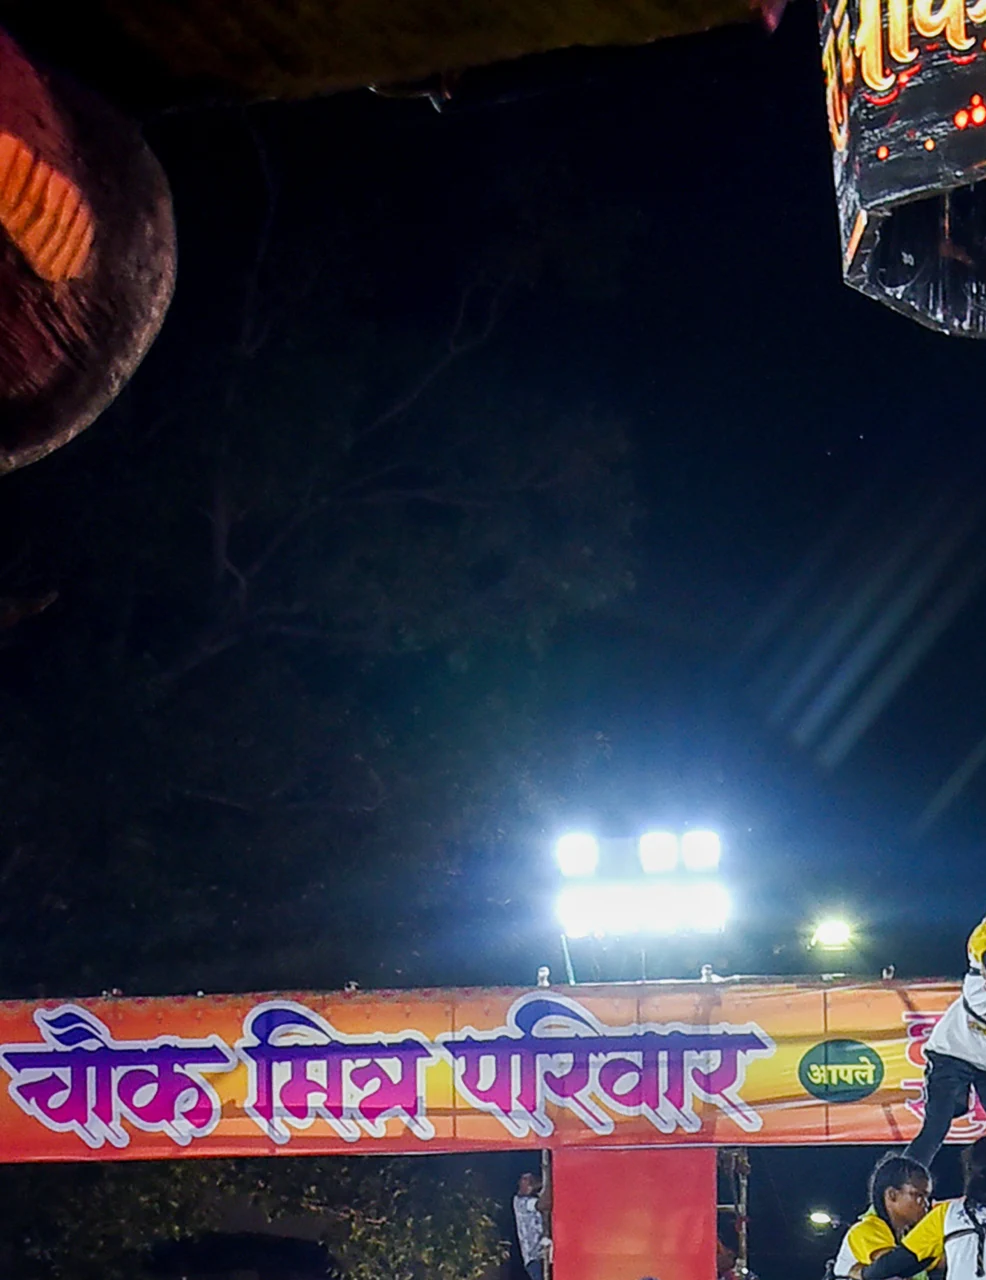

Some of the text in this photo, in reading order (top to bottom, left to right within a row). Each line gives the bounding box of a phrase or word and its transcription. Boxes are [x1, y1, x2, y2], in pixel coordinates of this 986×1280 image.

[2, 1000, 234, 1149] चौक
[235, 993, 438, 1145] मित्र
[442, 991, 777, 1138] परिवार
[807, 1056, 876, 1086] आपले
